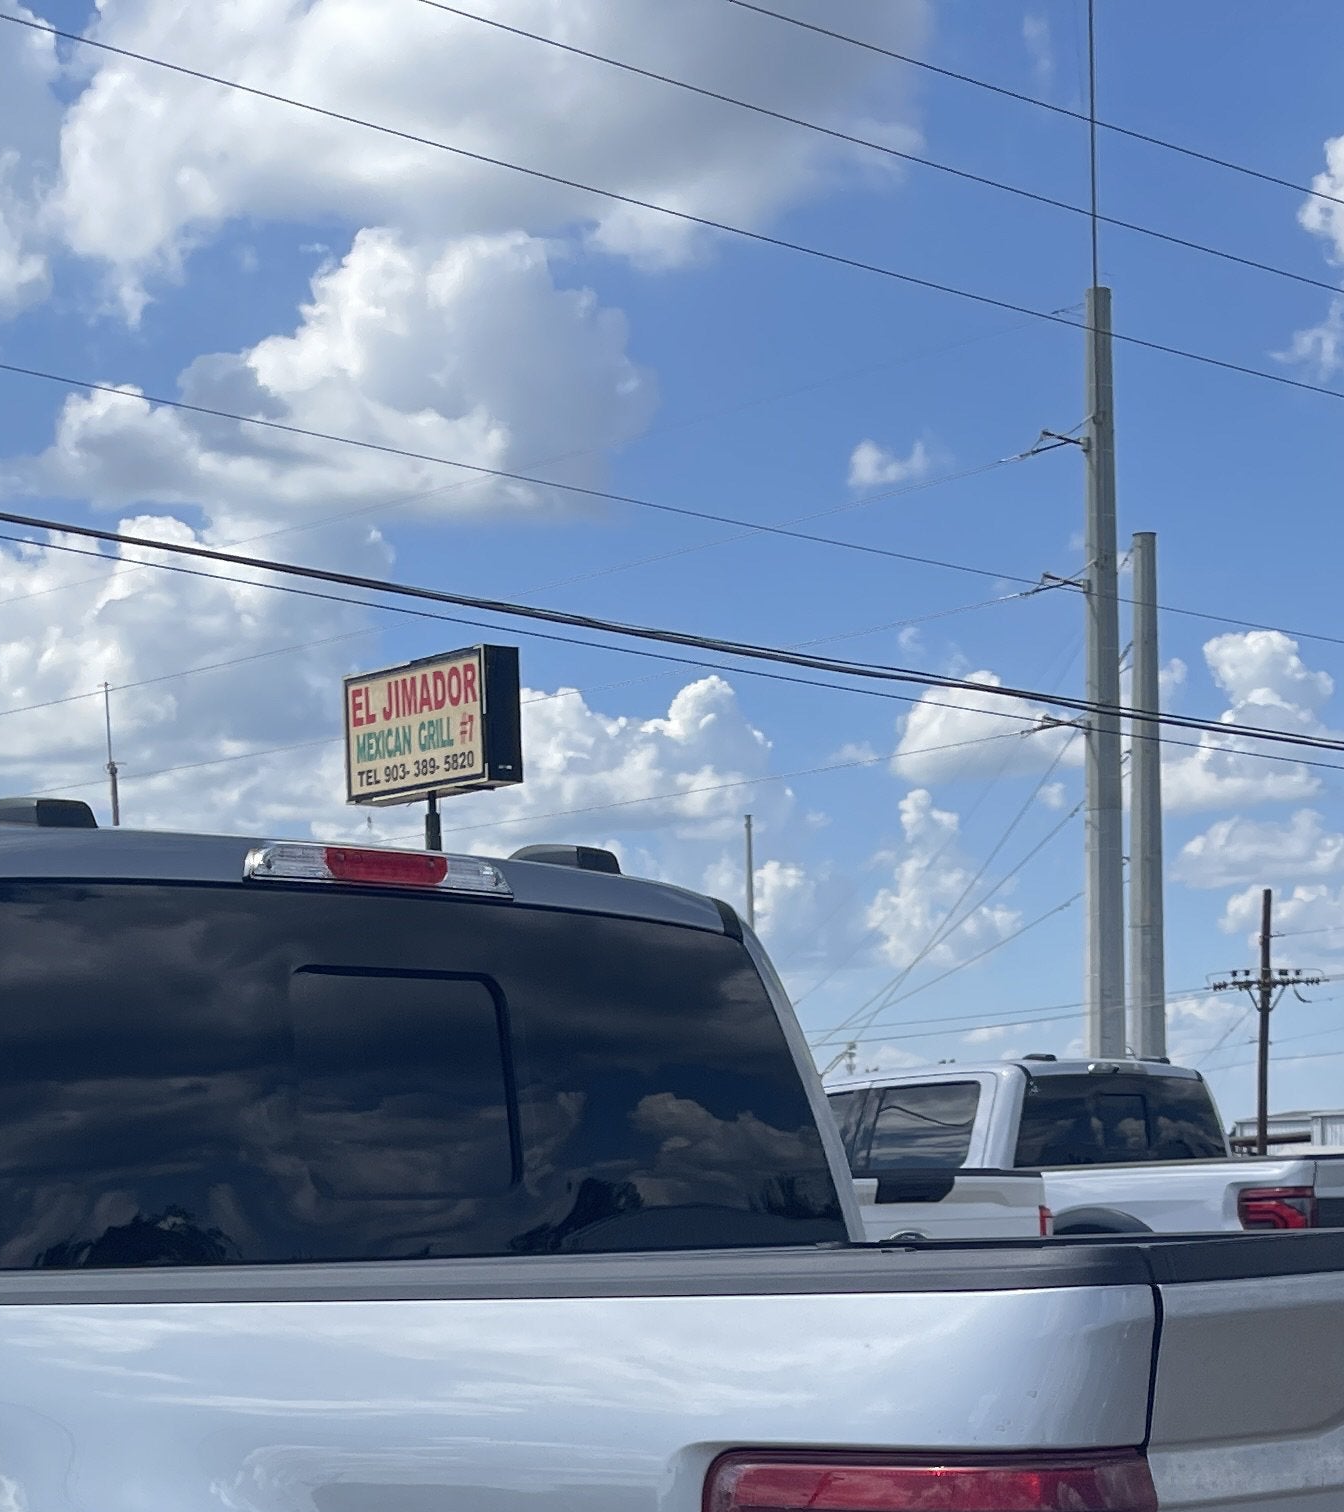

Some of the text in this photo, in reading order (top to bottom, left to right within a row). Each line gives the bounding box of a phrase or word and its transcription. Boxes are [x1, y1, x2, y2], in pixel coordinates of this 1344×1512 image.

[351, 663, 477, 728] EL JIMADOR
[356, 712, 474, 764] MEXICAN GRILL #7
[357, 768, 381, 787] TEL
[444, 750, 474, 772] 5820
